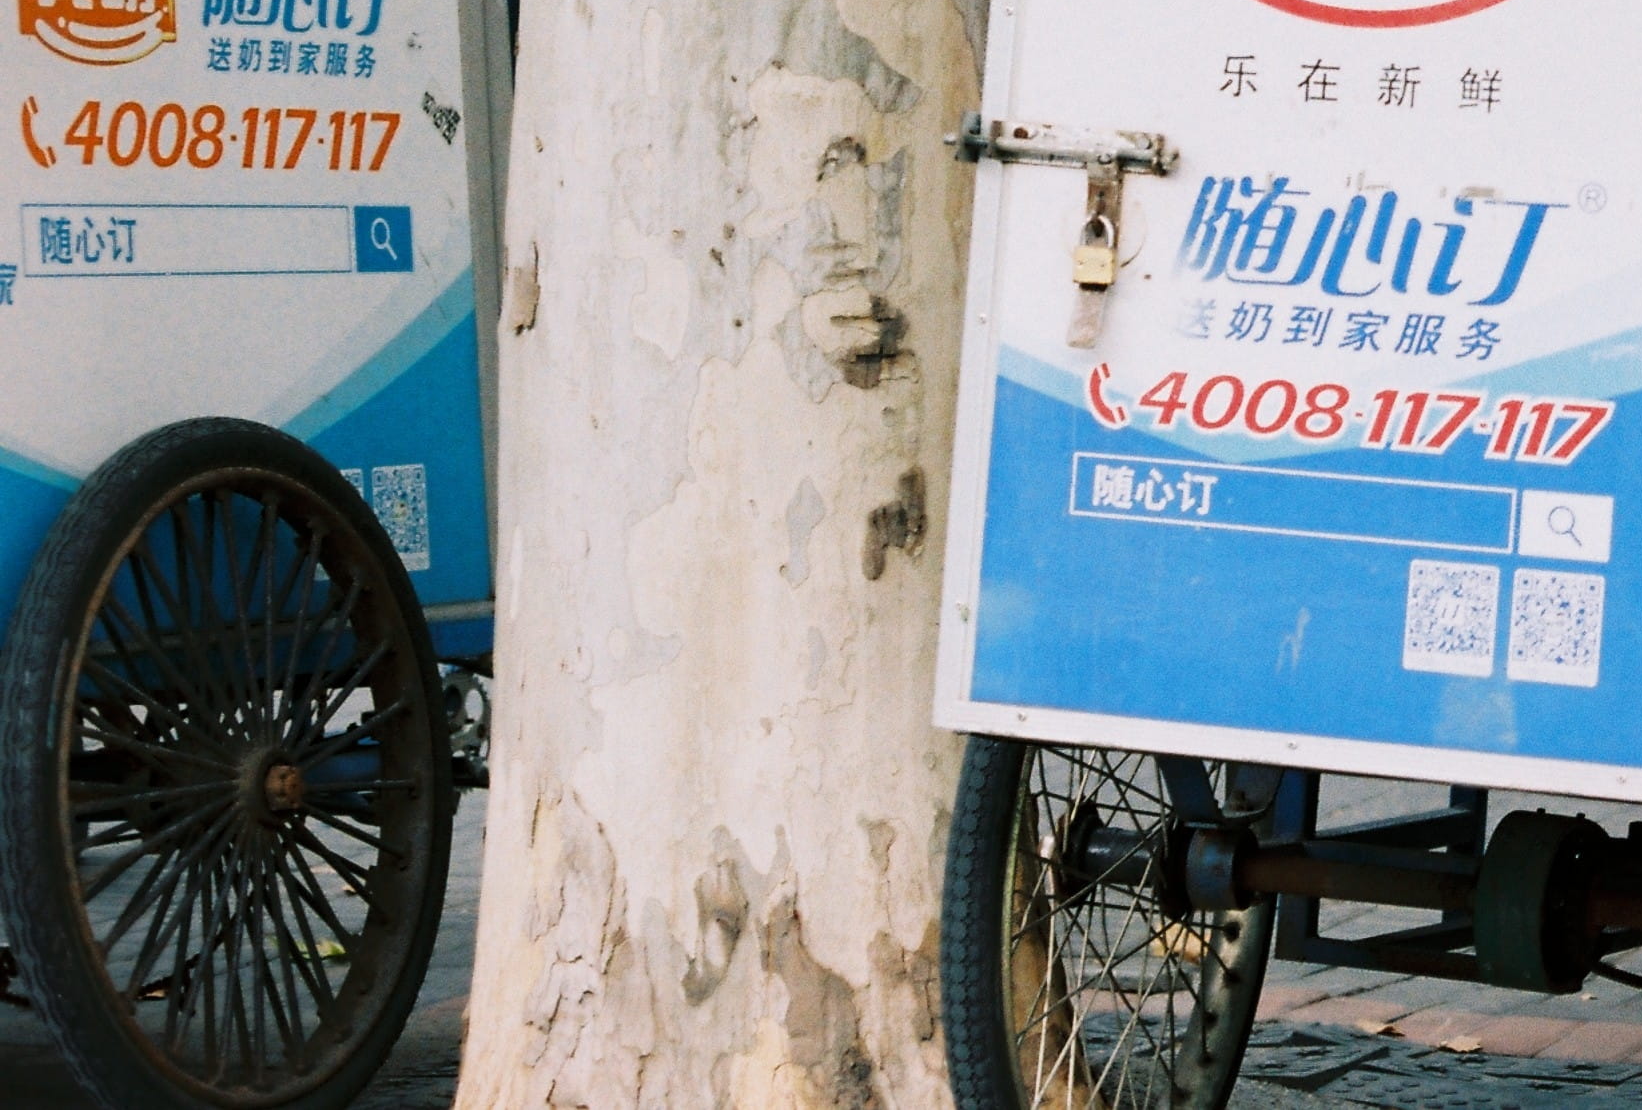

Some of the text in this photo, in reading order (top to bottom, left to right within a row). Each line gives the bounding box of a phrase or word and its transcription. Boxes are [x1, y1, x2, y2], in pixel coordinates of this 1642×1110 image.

[207, 38, 377, 78] 送奶到家服务
[1220, 55, 1502, 114] 乐在新鲜
[40, 216, 136, 265] 随心订
[1173, 175, 1570, 306] 随心订
[1091, 464, 1218, 518] 随心订
